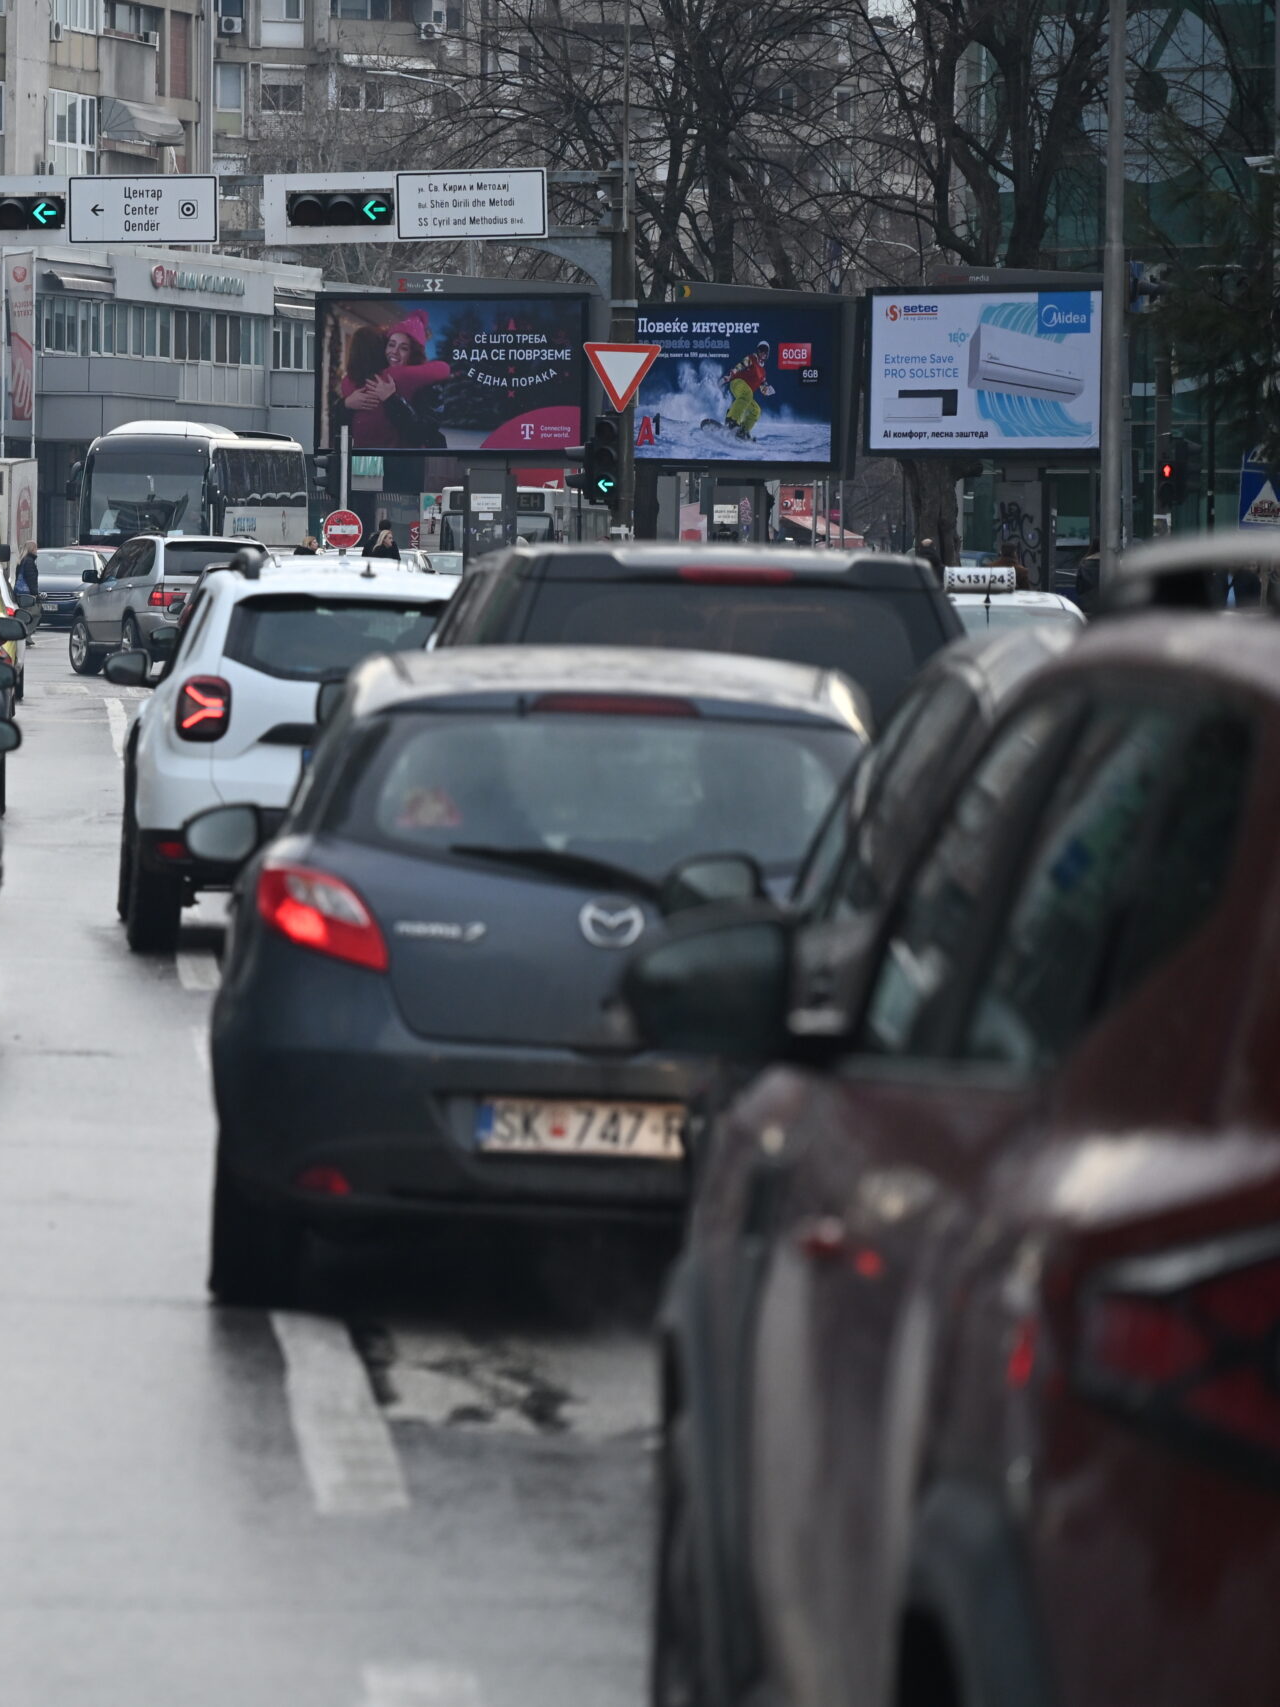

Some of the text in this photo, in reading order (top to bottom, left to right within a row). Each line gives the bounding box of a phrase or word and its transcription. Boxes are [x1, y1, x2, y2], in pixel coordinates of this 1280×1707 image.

[124, 186, 163, 201] Центар
[443, 183, 466, 193] Кирил
[476, 182, 509, 192] Методиј
[430, 200, 449, 208] Shën
[472, 198, 486, 208] dhe
[489, 197, 515, 207] Metodi
[124, 204, 159, 216] Center
[418, 217, 428, 227] SS
[433, 217, 450, 227] Cyril
[453, 217, 466, 225] and
[469, 216, 508, 225] Methodius
[903, 304, 938, 313] setec
[1041, 304, 1086, 327] Midea
[638, 317, 760, 337] Повеќе интернет
[489, 334, 514, 344] ШТО
[516, 334, 547, 344] ТРЕБА
[692, 336, 730, 349] забава
[452, 349, 572, 362] ЗА ДА СЕ ПОВРЗЕМЕ
[782, 349, 808, 360] 60GB
[884, 353, 954, 365] Extreme Save
[467, 368, 558, 388] Е ЕДНА ПОРАКА
[802, 369, 818, 379] 6GB
[884, 367, 959, 379] PRO SOLSTICE
[636, 412, 661, 446] A1
[883, 429, 989, 440] AI комфорт, лесна заштеда
